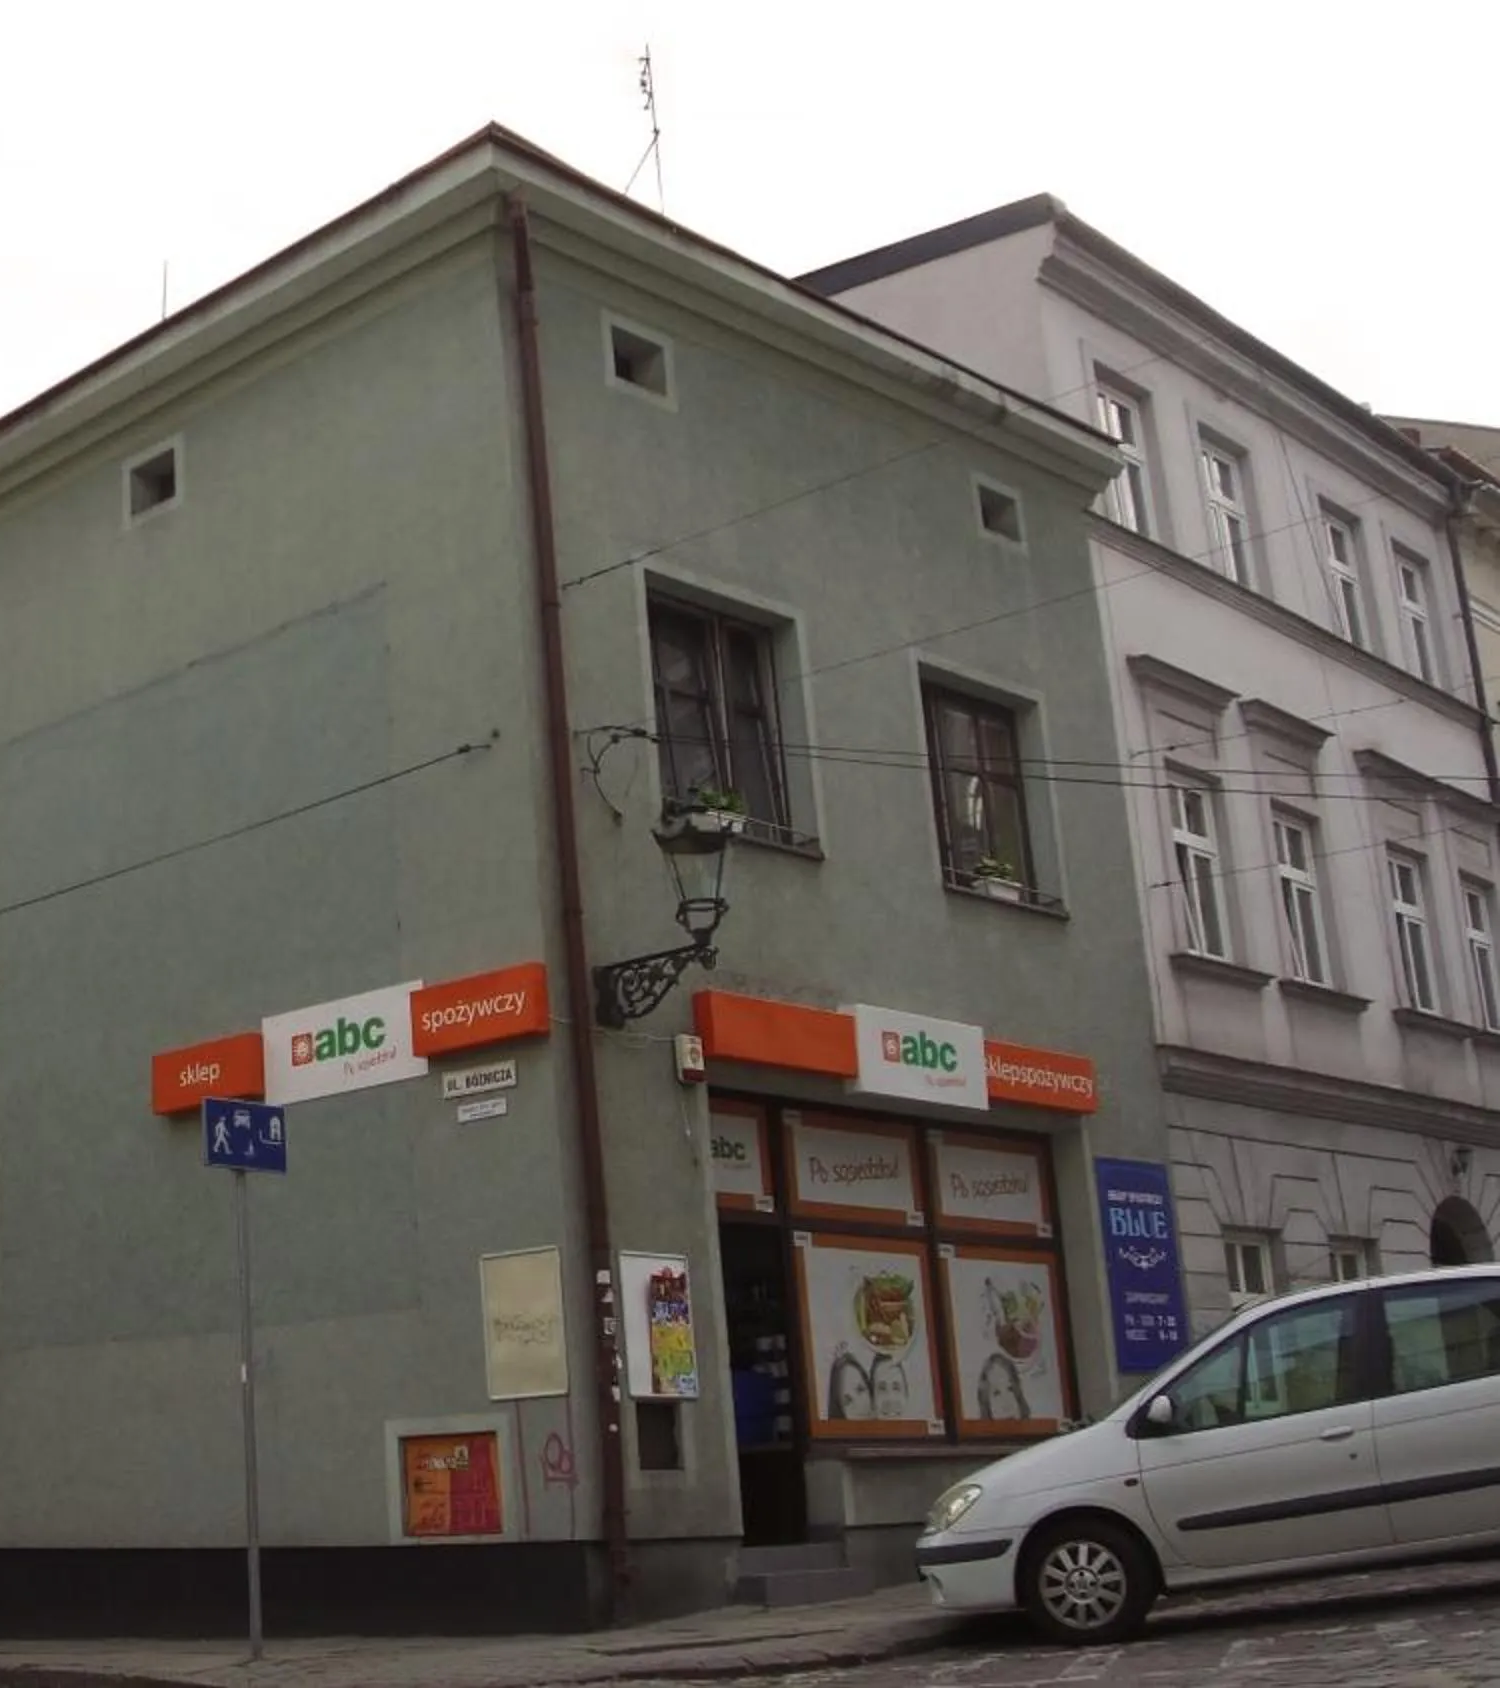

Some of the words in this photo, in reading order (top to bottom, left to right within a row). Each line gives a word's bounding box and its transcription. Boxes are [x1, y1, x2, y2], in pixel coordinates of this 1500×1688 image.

[421, 991, 525, 1033] spożywczy
[315, 1017, 386, 1062] abc
[902, 1030, 958, 1073] abc
[179, 1062, 221, 1088] sklep
[711, 1136, 746, 1161] abc
[1109, 1207, 1168, 1239] BLUE
